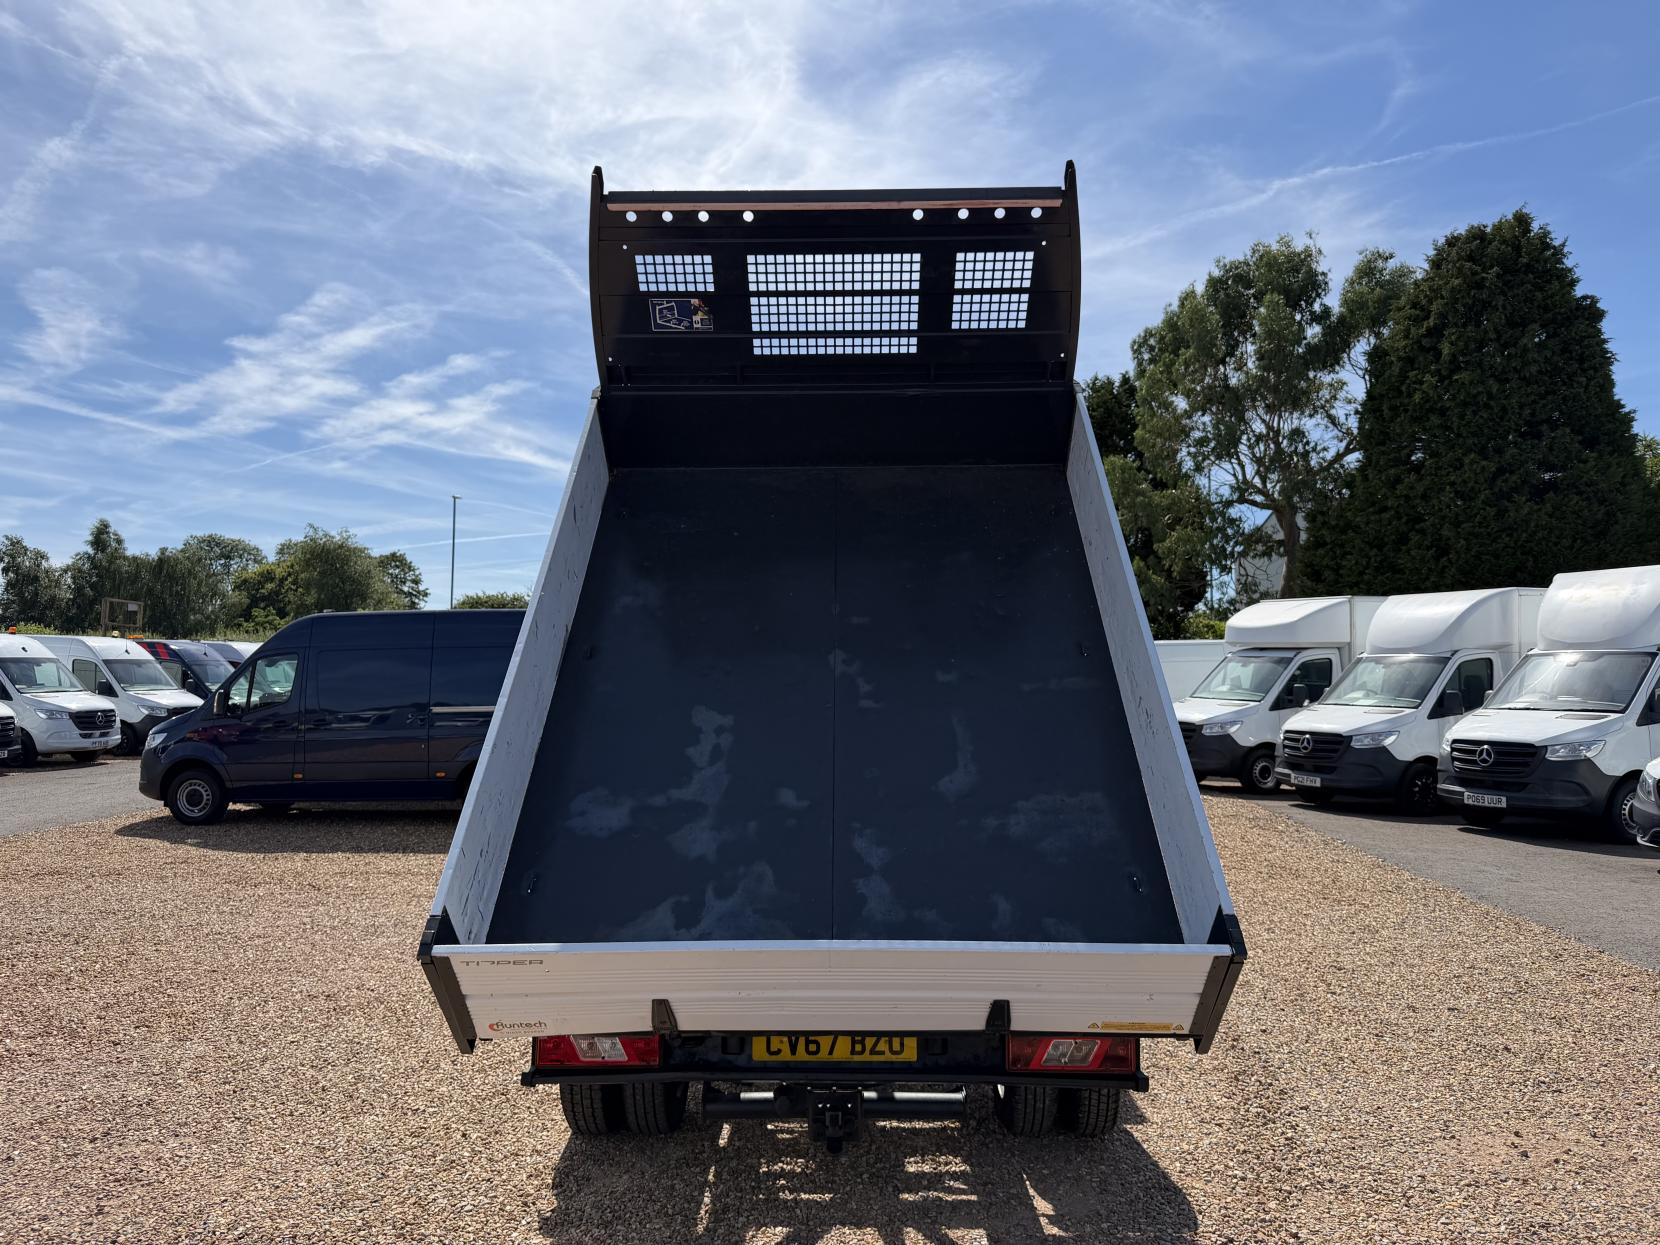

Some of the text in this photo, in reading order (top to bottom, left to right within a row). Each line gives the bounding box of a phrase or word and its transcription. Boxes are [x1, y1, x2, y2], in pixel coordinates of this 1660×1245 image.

[1466, 794, 1503, 806] PO69 UUR
[459, 959, 543, 967] TIPPER
[765, 1035, 840, 1056] CV67
